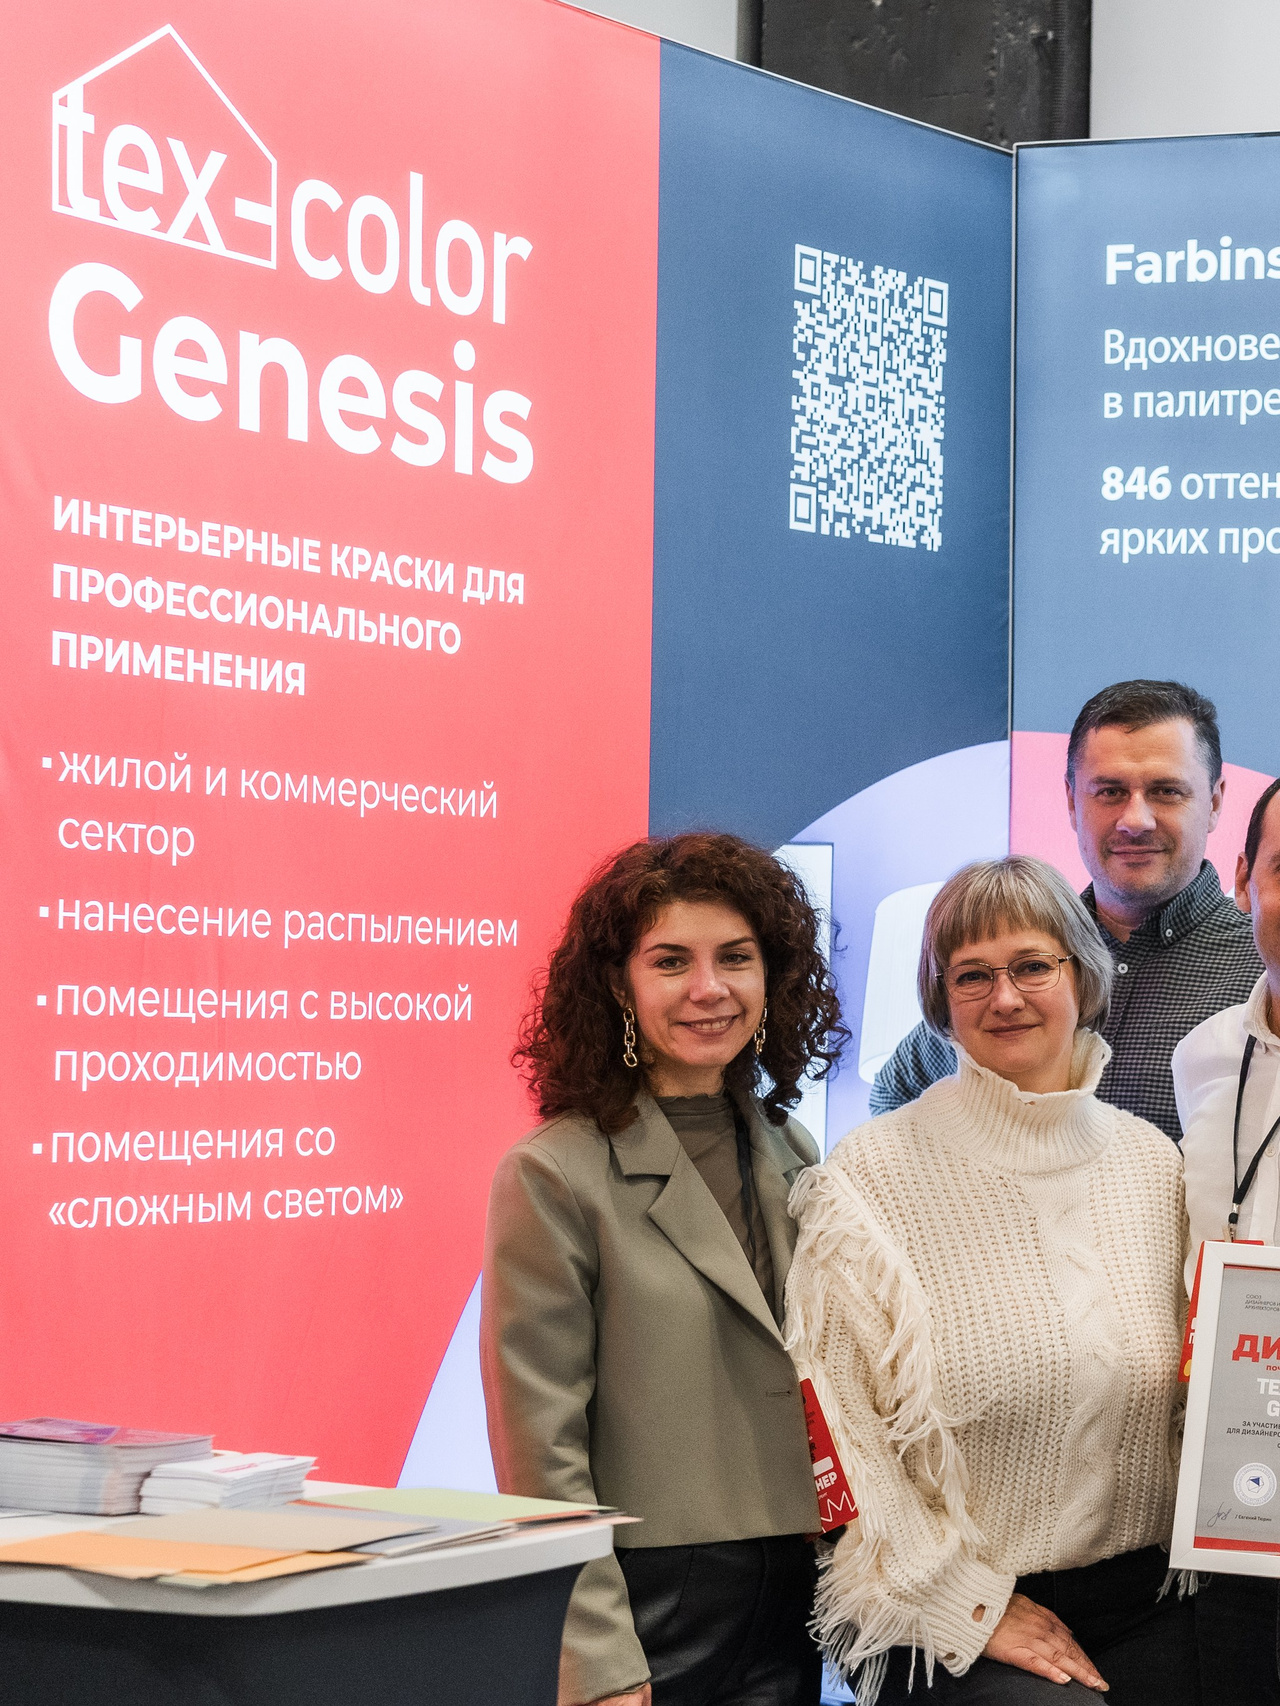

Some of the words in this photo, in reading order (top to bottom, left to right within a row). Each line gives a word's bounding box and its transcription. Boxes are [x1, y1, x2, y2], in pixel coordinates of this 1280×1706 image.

[55, 82, 533, 325] tex-color
[49, 262, 533, 484] Genesis
[1103, 392, 1124, 419] в
[1101, 465, 1172, 501] 846
[52, 495, 321, 575] ИНТЕРЬЕРНЫЕ
[331, 543, 454, 595] КРАСКИ
[462, 565, 525, 606] ДЛЯ
[1099, 527, 1209, 564] ярких
[52, 563, 462, 655] ПРОФЕССИОНАЛЬНОГО
[51, 630, 305, 696] ПРИМЕНЕНИЯ
[58, 750, 191, 794] жилой
[205, 765, 227, 797] и
[240, 768, 497, 819] коммерческий
[58, 817, 195, 867] сектор
[58, 898, 272, 939] нанесение
[284, 910, 518, 949] распылением
[56, 984, 288, 1024] помещения
[300, 990, 319, 1020] с
[330, 983, 472, 1021] высокой
[54, 1049, 362, 1091] проходимостью
[51, 1128, 284, 1166] помещения
[295, 1126, 336, 1157] со
[48, 1191, 252, 1229] «сложным
[263, 1184, 404, 1220] светом»
[1226, 1427, 1241, 1435] ДЛЯ
